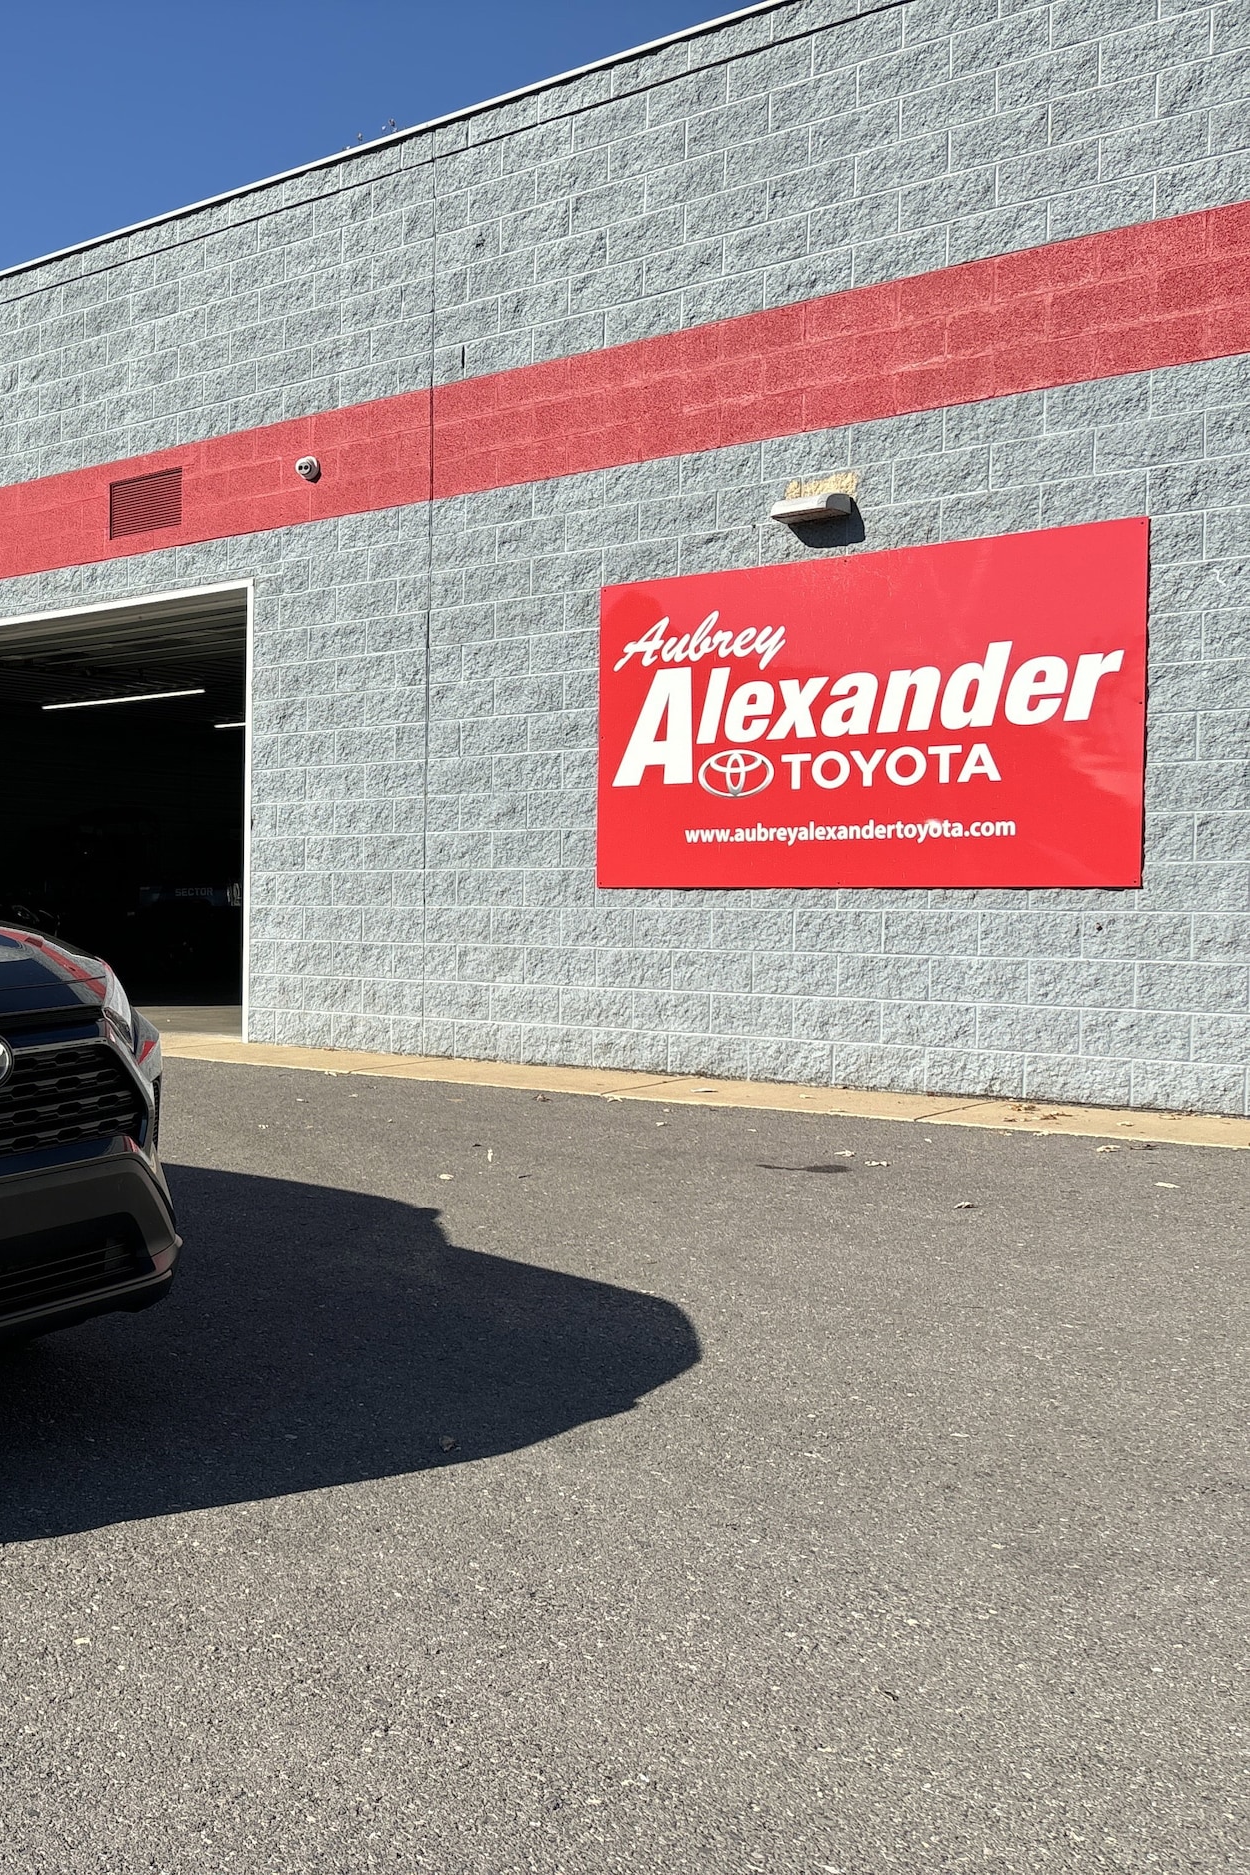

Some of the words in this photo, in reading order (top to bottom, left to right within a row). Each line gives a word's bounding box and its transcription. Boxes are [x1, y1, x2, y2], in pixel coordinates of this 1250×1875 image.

[613, 610, 786, 672] Aubrey
[611, 640, 1125, 788] Alexander
[780, 743, 1002, 791] TOYOTA
[684, 819, 1016, 848] www.aubreyalexandertoyota.com
[174, 887, 214, 897] SECTOR
